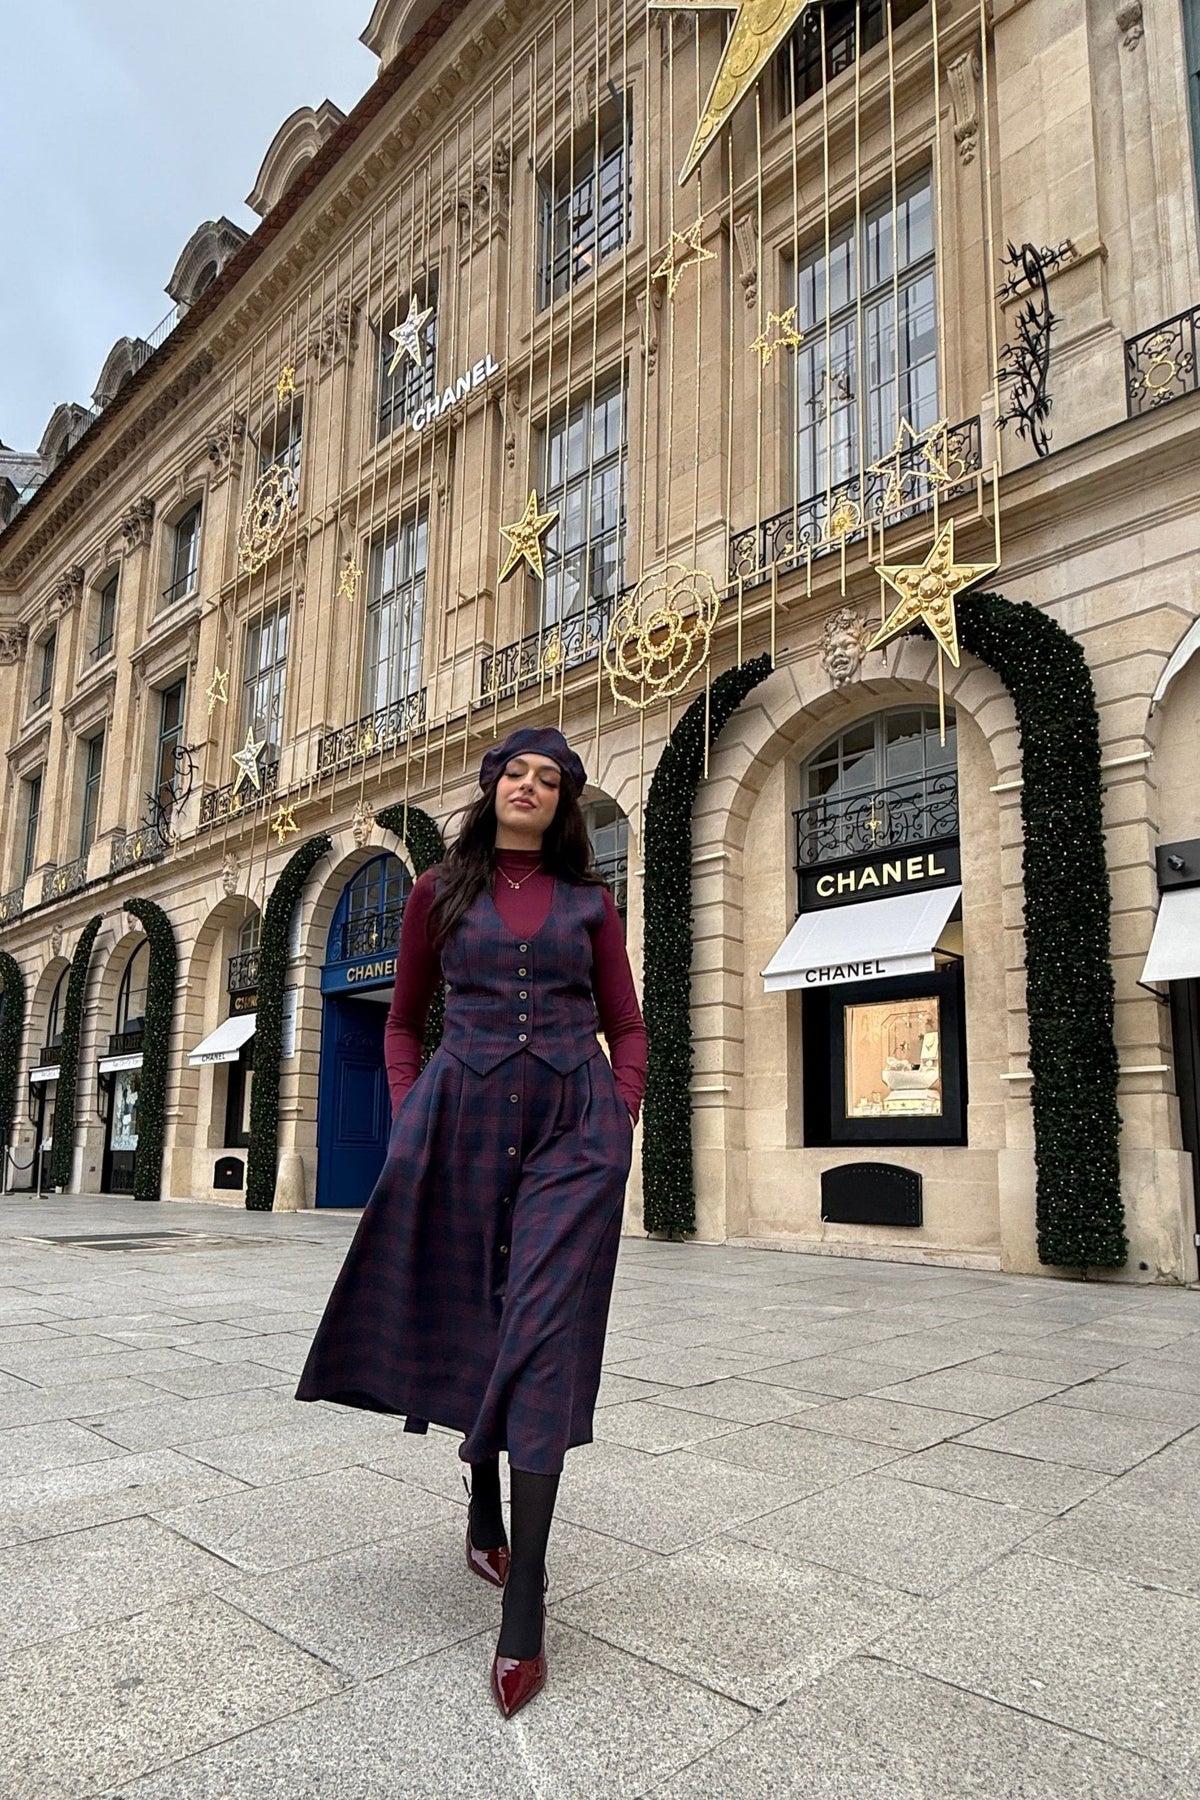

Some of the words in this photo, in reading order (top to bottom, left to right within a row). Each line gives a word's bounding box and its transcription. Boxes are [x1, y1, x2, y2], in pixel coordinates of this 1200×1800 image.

[412, 353, 499, 432] CHANEL
[816, 854, 945, 896] CHANEL
[805, 959, 886, 983] CHANEL
